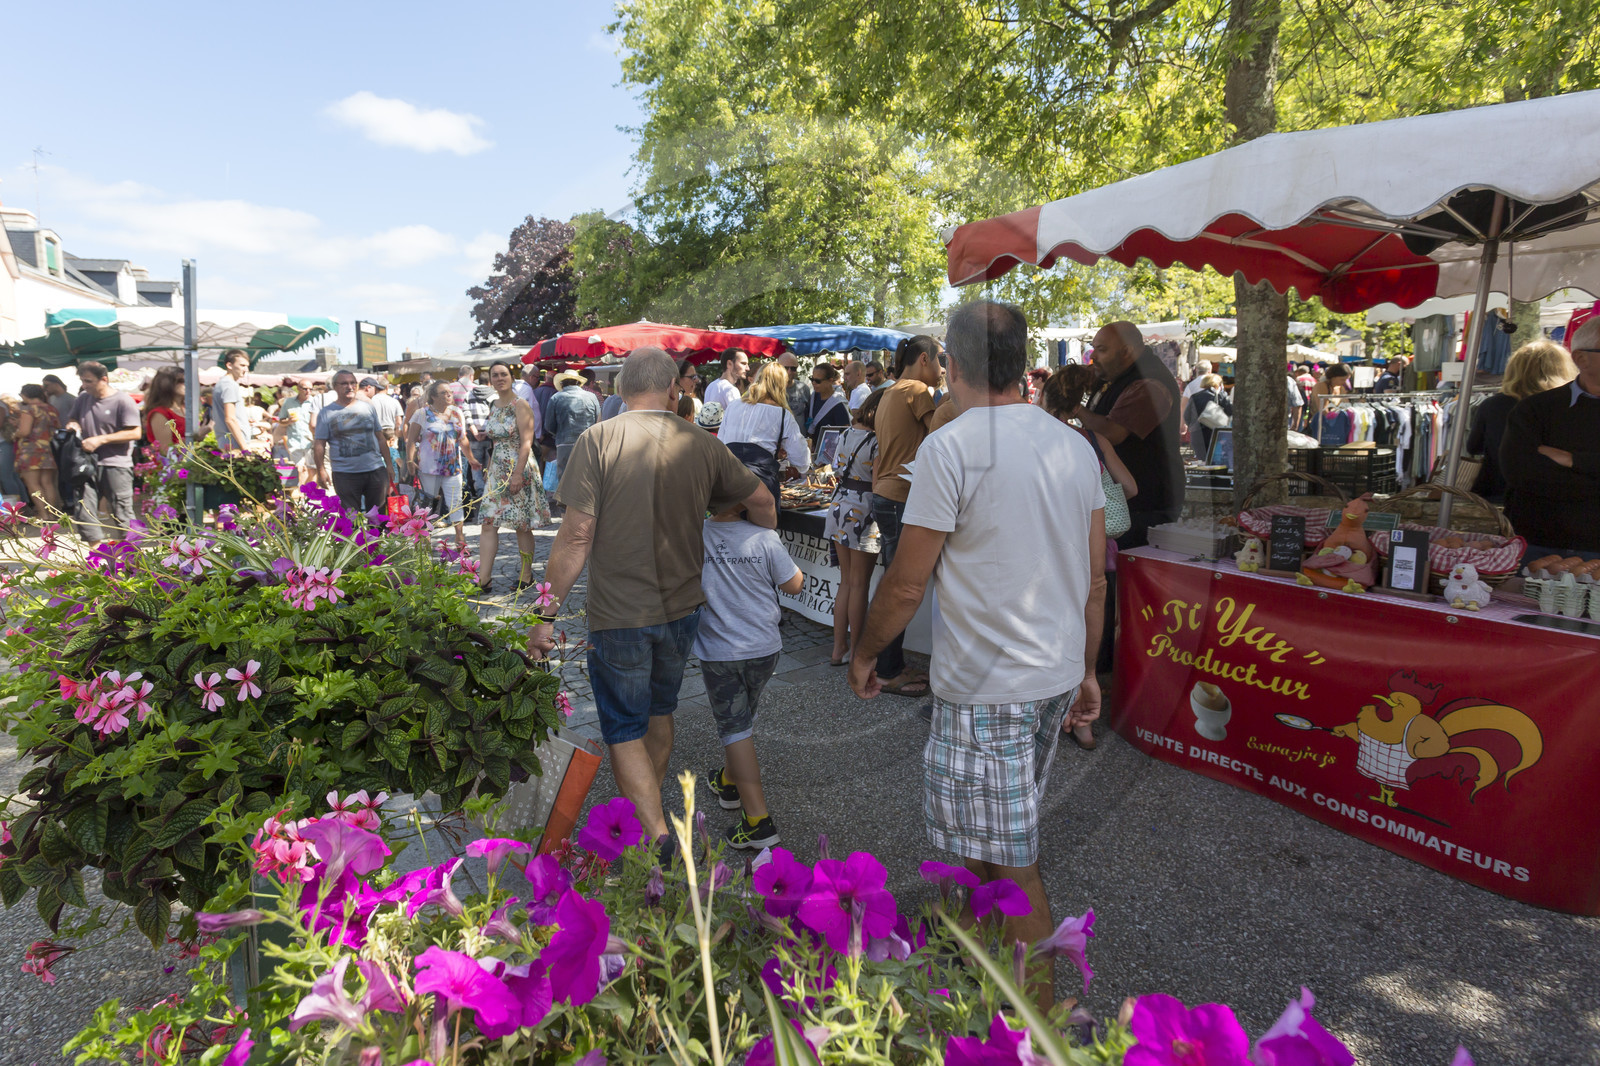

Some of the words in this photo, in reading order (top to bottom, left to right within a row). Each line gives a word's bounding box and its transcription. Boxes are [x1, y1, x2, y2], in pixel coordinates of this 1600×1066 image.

[727, 556, 762, 564] FRANCE
[1135, 726, 1184, 754] VENTE
[1189, 745, 1264, 781] DIRECTE
[1268, 775, 1308, 800] AUX
[1312, 792, 1531, 882] CONSOMMATEURS
